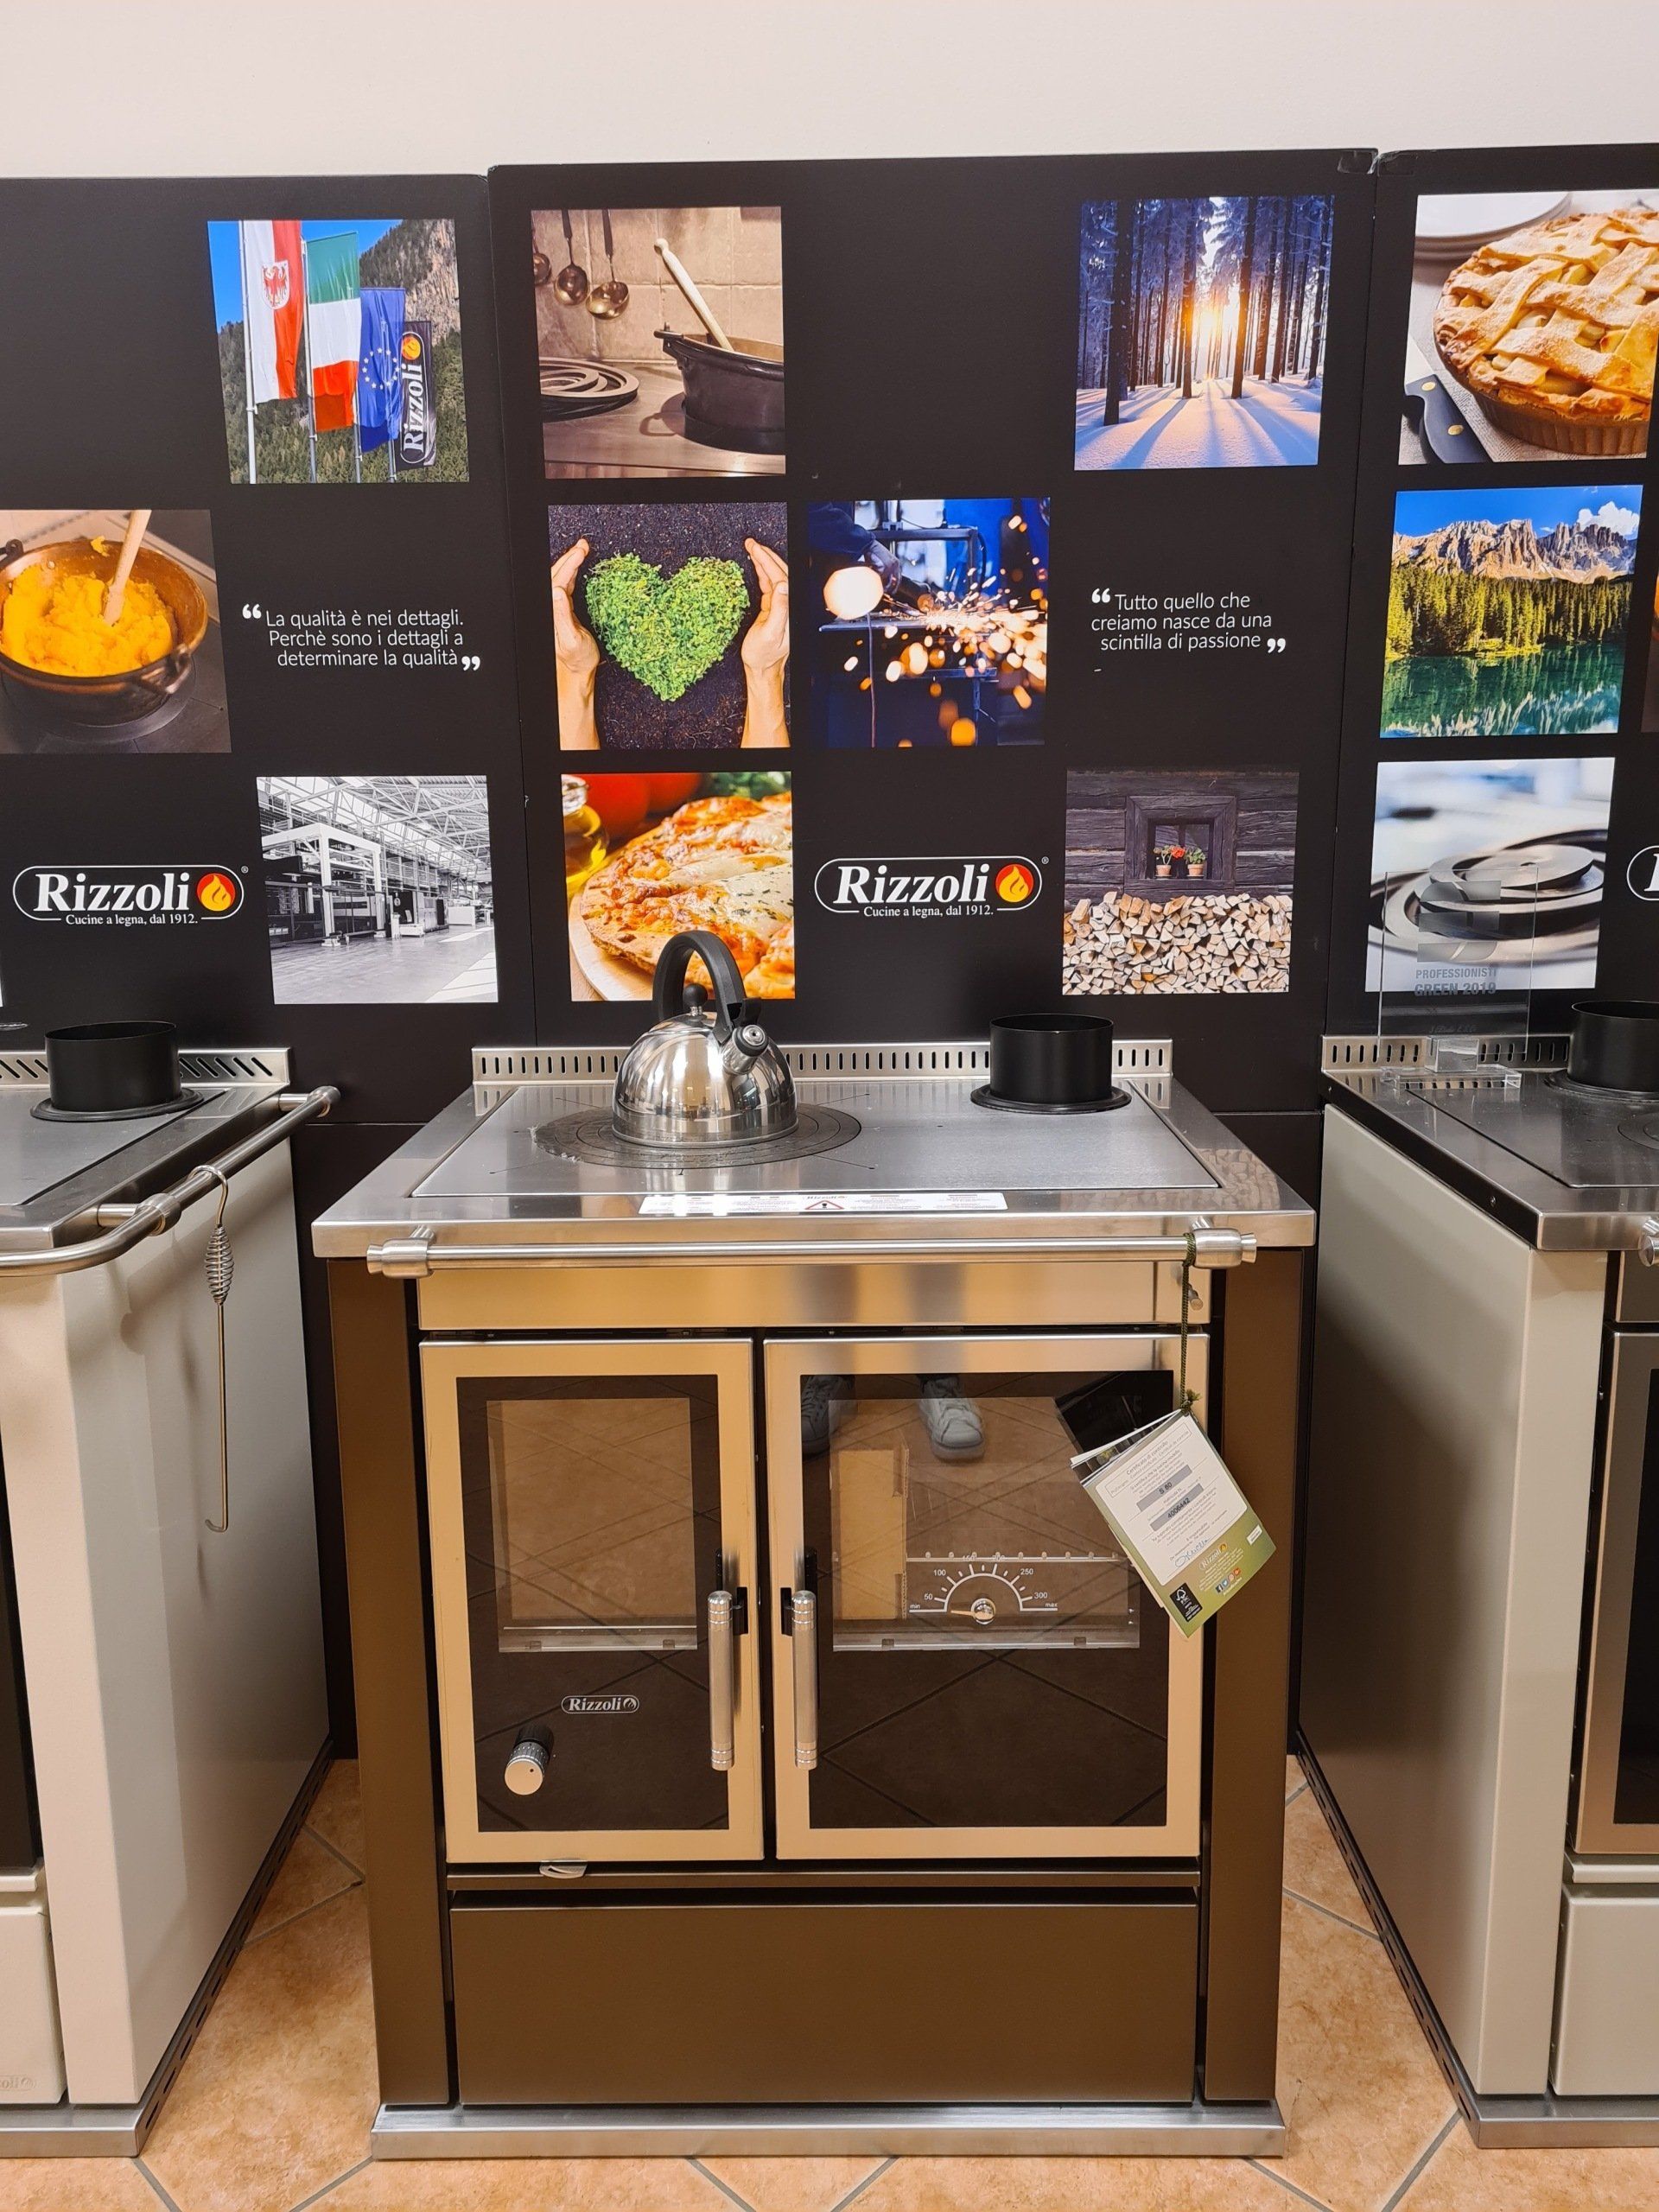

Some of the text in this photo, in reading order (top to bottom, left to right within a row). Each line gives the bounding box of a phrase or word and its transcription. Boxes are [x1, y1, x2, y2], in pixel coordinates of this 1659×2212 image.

[402, 364, 423, 452] Rizzoli
[1163, 592, 1215, 613] quello
[1220, 592, 1250, 608] che
[290, 610, 346, 629] qualità
[351, 610, 362, 626] è
[367, 610, 391, 626] nei
[397, 609, 464, 629] dettagli.
[1091, 612, 1272, 631] creiamo nasce da una
[269, 630, 463, 649] Perchè sono i dettagli a
[1100, 633, 1162, 651] scintilla
[1167, 632, 1183, 649] di
[277, 650, 378, 666] determinare
[384, 649, 397, 665] la
[33, 872, 190, 912] Rizzoli
[833, 863, 990, 904] Rizzoli
[66, 913, 198, 926] Cucine a legna, dal 1912.
[864, 906, 900, 917] Cucine
[912, 906, 944, 918] legna,
[945, 905, 962, 916] dal
[966, 904, 994, 916] 1912.
[1415, 967, 1497, 979] PROFESSIONISTI
[1414, 982, 1497, 996] GREEN 2019
[569, 1697, 621, 1711] Rizzoli
